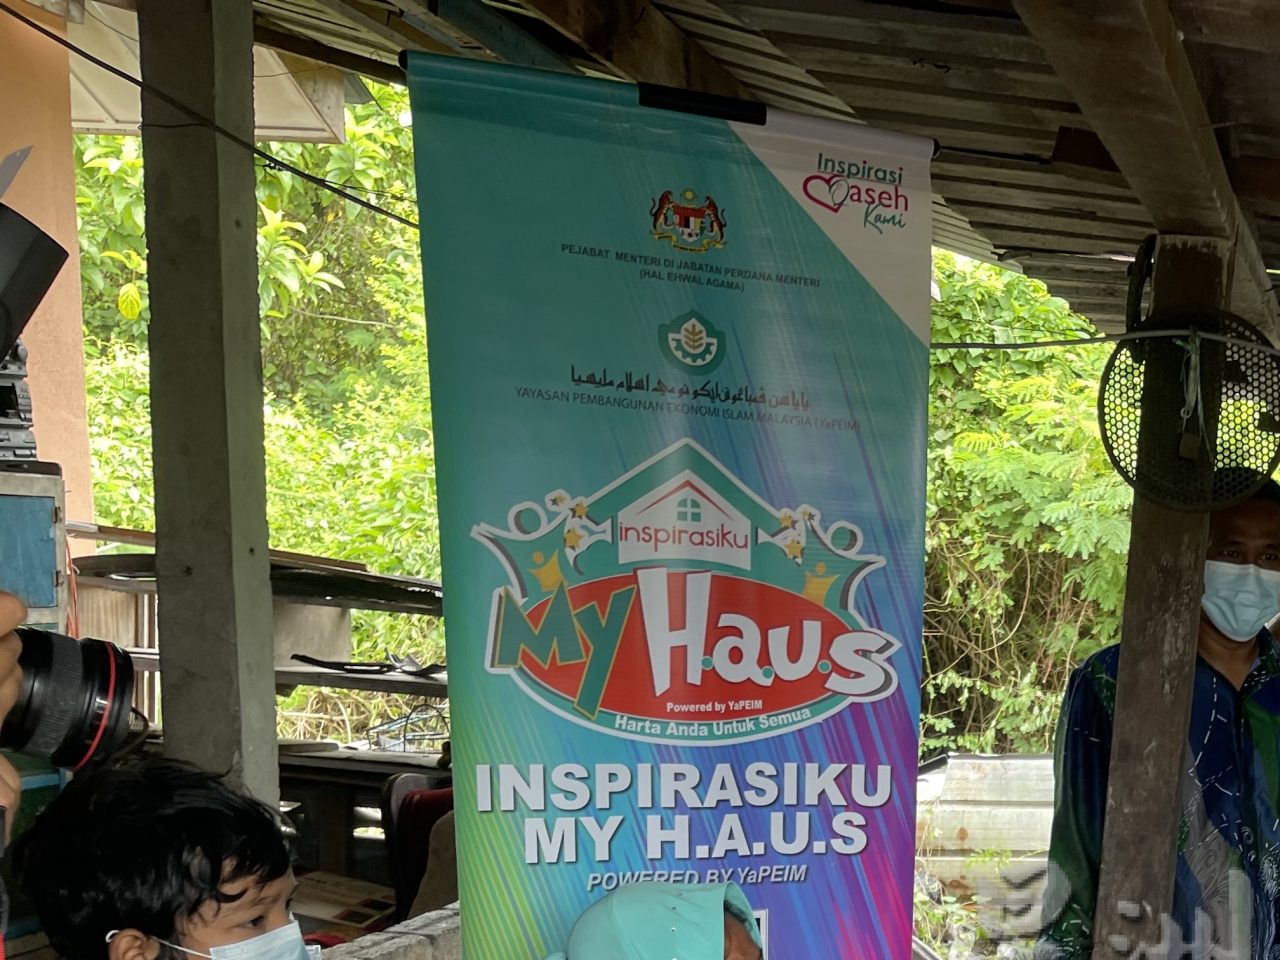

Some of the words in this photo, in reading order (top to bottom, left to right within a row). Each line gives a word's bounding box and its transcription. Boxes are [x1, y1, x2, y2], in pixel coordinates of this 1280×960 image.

[816, 152, 904, 185] Inspirasi
[863, 203, 906, 235] Kami
[561, 243, 611, 259] PEJABAT
[615, 251, 661, 267] MENTERI
[663, 259, 675, 269] DI
[676, 260, 722, 275] JABATAN
[724, 266, 774, 282] PERDANA
[775, 274, 821, 288] MENTERI
[639, 268, 664, 281] (HAL
[666, 272, 704, 286] EHWAL
[705, 277, 745, 294] AGAMA)
[514, 386, 570, 403] YAYASAN
[573, 391, 664, 413] PEMBANGUNAN
[666, 402, 720, 418] EKONOMI
[722, 407, 754, 422] ISLAM
[756, 411, 812, 427] MALAYSIA
[619, 521, 749, 552] inspirasiku
[614, 714, 661, 735] Harta
[666, 723, 709, 737] Anda
[713, 719, 756, 736] Untuk
[759, 708, 812, 729] Semua
[666, 702, 712, 713] Powered
[714, 701, 726, 714] by
[728, 700, 763, 712] YaPEIM
[475, 761, 893, 812] INSPIRASIKU
[524, 816, 625, 865] MY
[646, 812, 869, 860] H.A.U.S
[586, 870, 700, 892] POWERED
[705, 868, 734, 885] BY
[738, 864, 808, 885] YaPEIM
